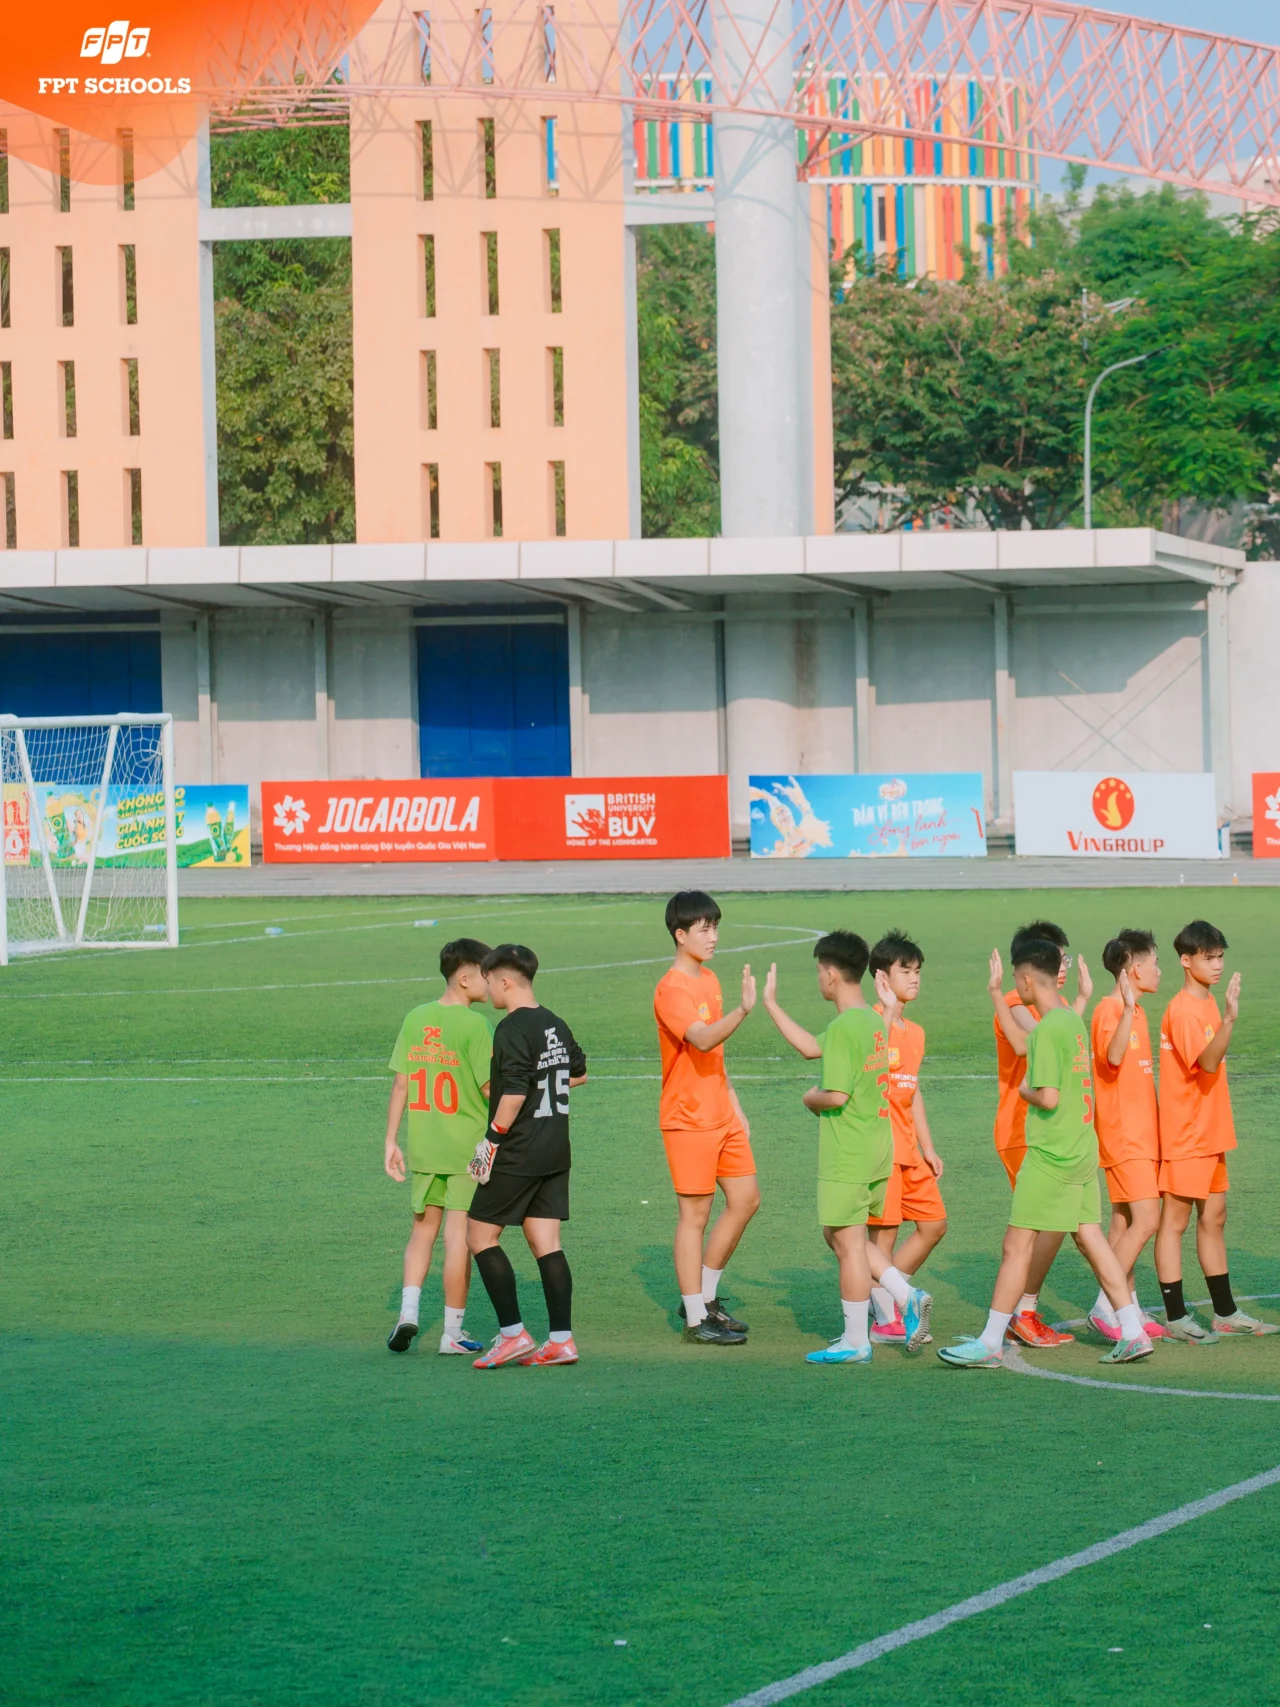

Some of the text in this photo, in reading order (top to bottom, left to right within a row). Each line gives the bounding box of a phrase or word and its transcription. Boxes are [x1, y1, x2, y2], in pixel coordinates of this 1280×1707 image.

[607, 793, 656, 804] BRITISH
[608, 804, 656, 812] UNIVERSITY
[318, 796, 480, 833] JOGARBOLA
[608, 816, 656, 838] BUV
[423, 1026, 442, 1048] 25
[408, 1068, 458, 1115] 10
[533, 1069, 569, 1119] 15
[877, 1073, 889, 1118] 3
